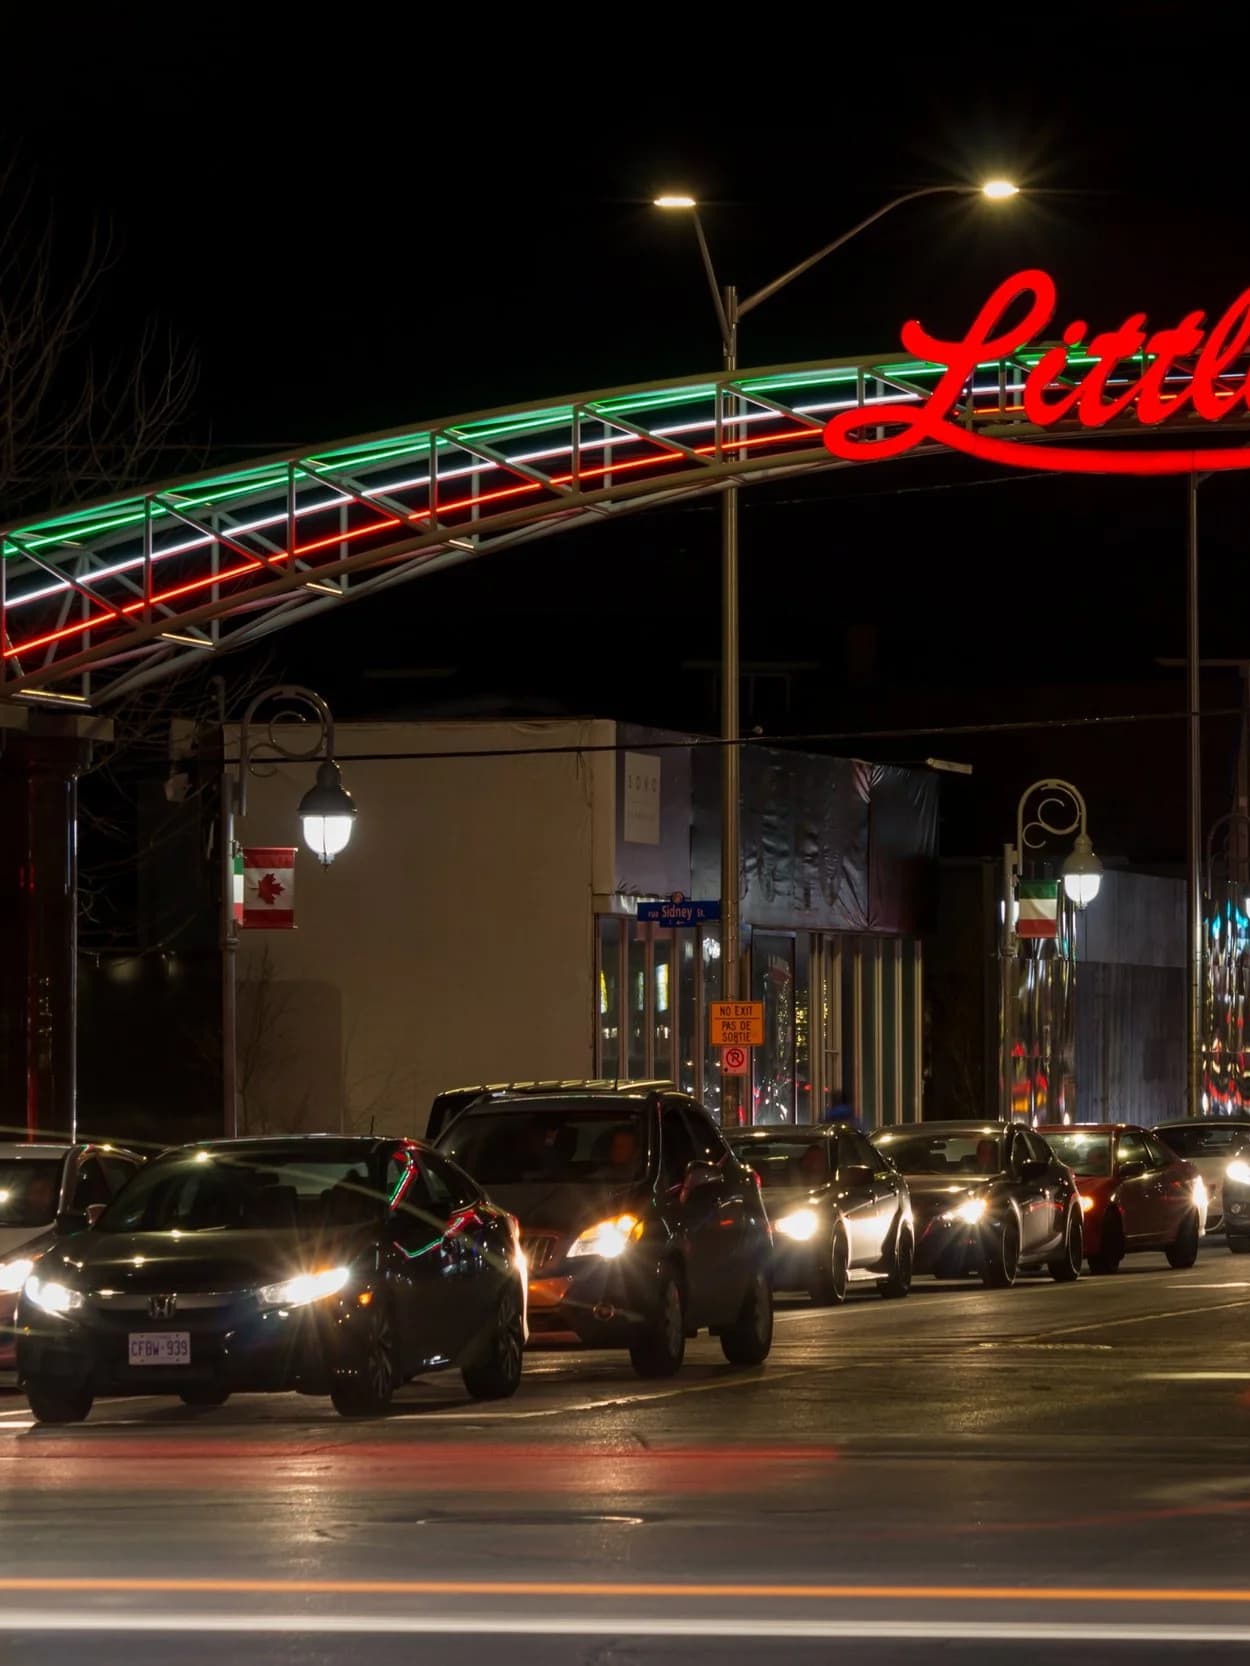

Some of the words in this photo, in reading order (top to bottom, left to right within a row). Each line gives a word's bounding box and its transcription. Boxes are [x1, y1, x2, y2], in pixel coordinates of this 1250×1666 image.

[662, 904, 692, 920] Sidney
[720, 1006, 731, 1016] NO
[735, 1006, 752, 1016] EXIT
[722, 1021, 736, 1030] PAS
[740, 1021, 751, 1030] DE
[722, 1032, 751, 1041] SORTIE
